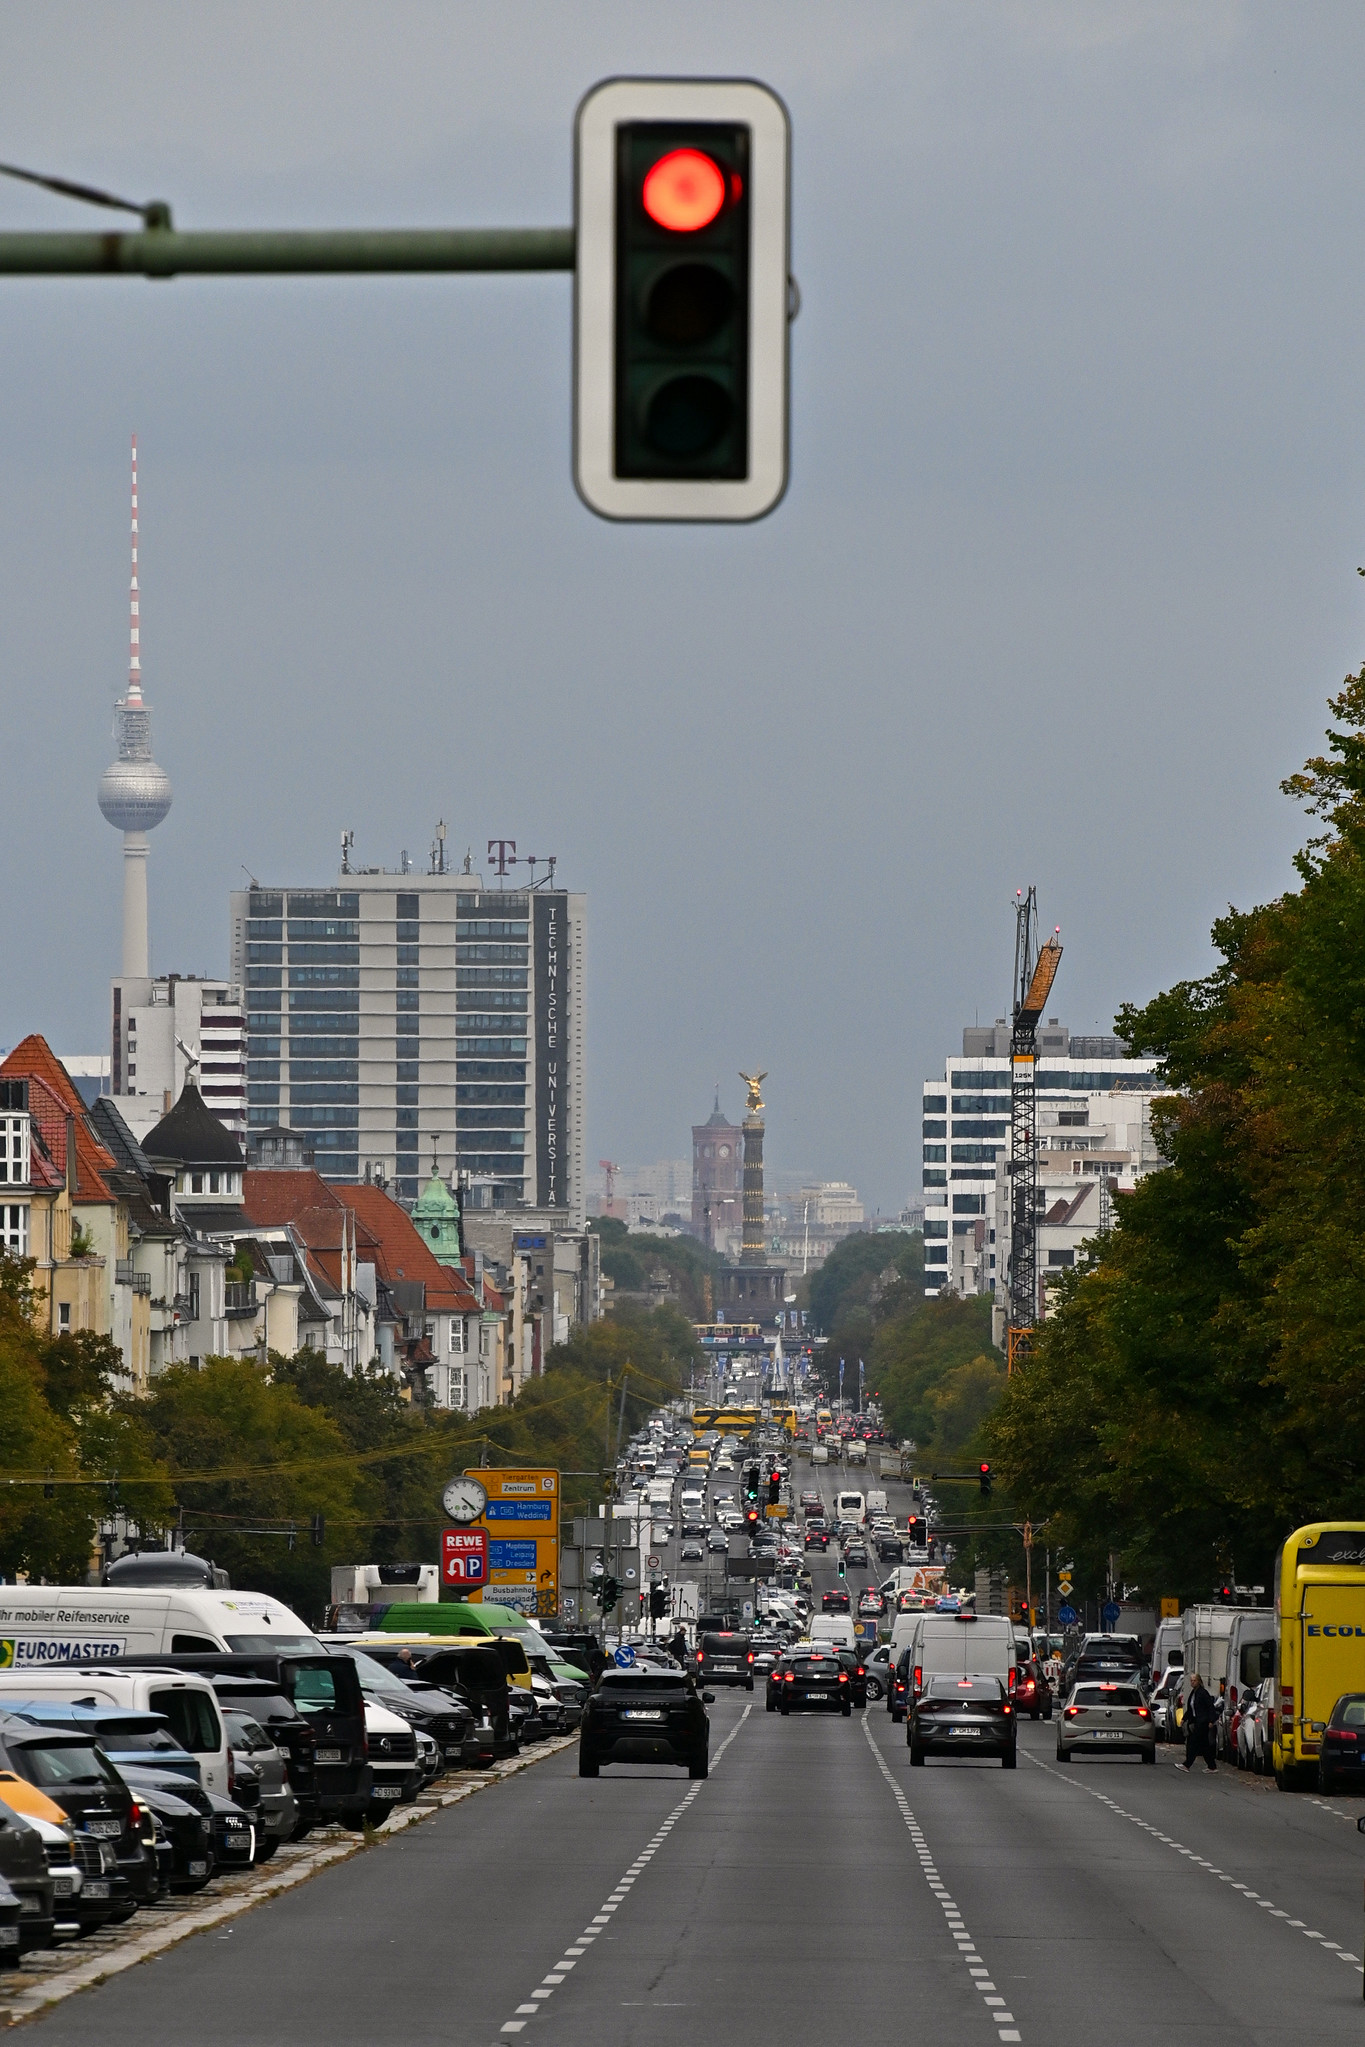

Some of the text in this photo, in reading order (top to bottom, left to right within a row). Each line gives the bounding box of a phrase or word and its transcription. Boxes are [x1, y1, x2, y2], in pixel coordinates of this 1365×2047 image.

[548, 908, 557, 1207] TECHNISCHE UNIVERSITÄ
[502, 1474, 539, 1483] Tiergarten
[503, 1484, 535, 1492] Zentrum
[516, 1502, 550, 1511] Hamburg
[516, 1511, 548, 1520] Wedding
[446, 1535, 484, 1547] REWE
[510, 1551, 535, 1559] Leipzig
[468, 1558, 480, 1576] P
[492, 1586, 535, 1594] Busbahnhof
[15, 1609, 55, 1622] mobiler
[57, 1610, 130, 1624] Reifenservice
[16, 1641, 120, 1660] EUROMASTER
